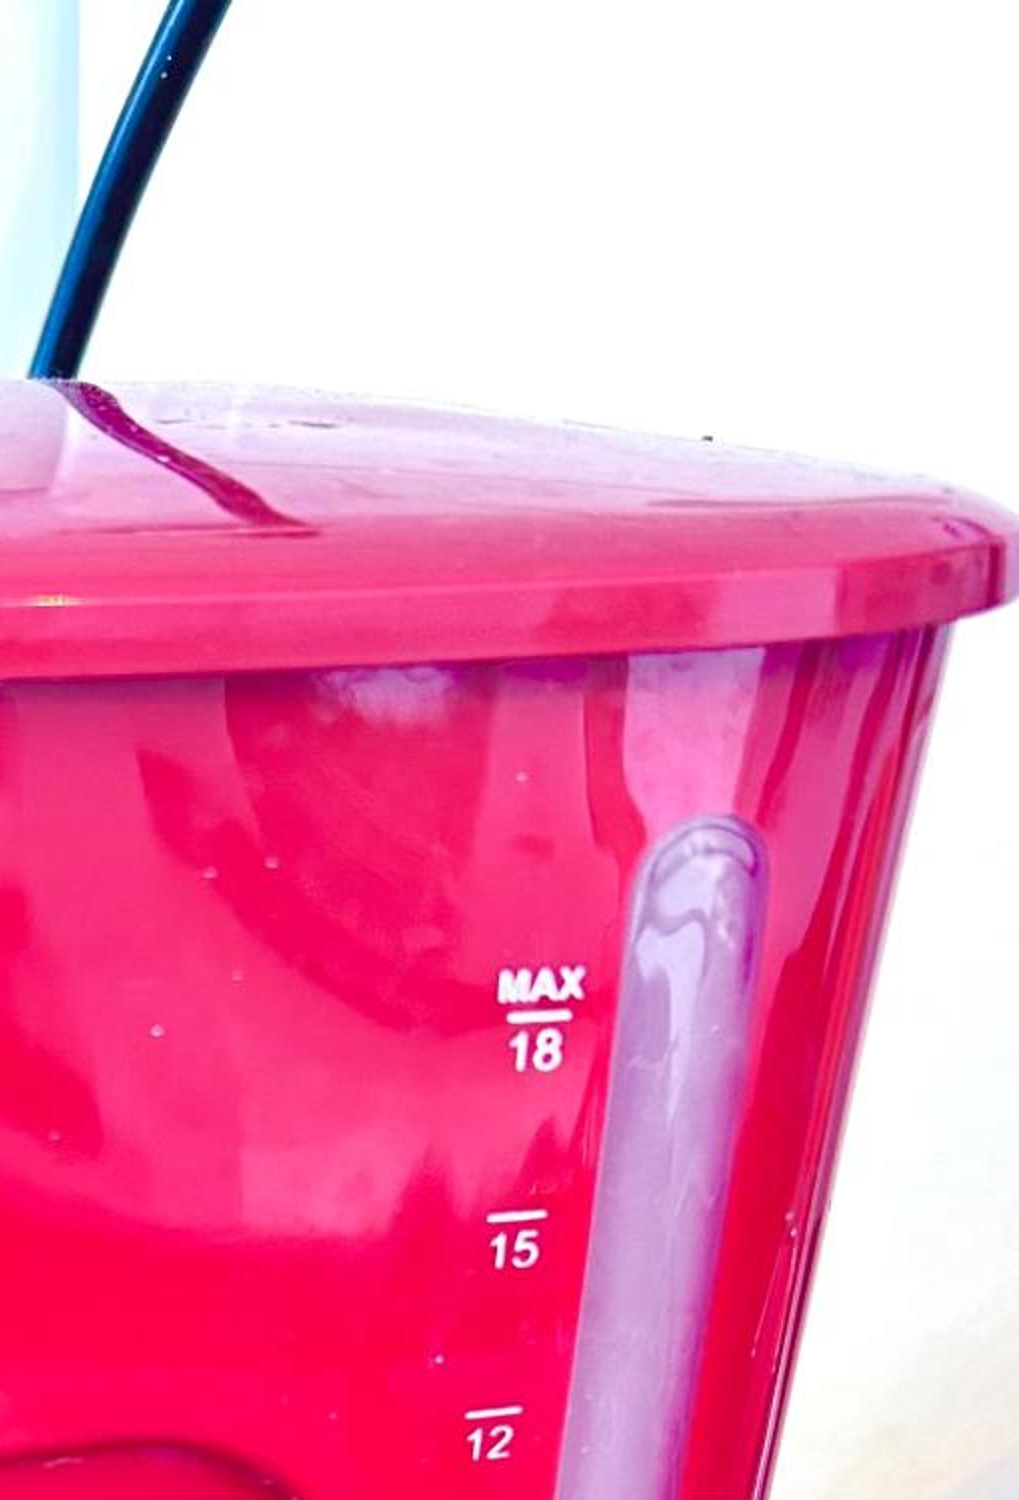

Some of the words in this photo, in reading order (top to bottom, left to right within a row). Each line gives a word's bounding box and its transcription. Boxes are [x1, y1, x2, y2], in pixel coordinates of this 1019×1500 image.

[496, 966, 587, 1004] MAX
[508, 1027, 564, 1073] 18
[488, 1229, 541, 1270] 15
[465, 1424, 516, 1462] 12
